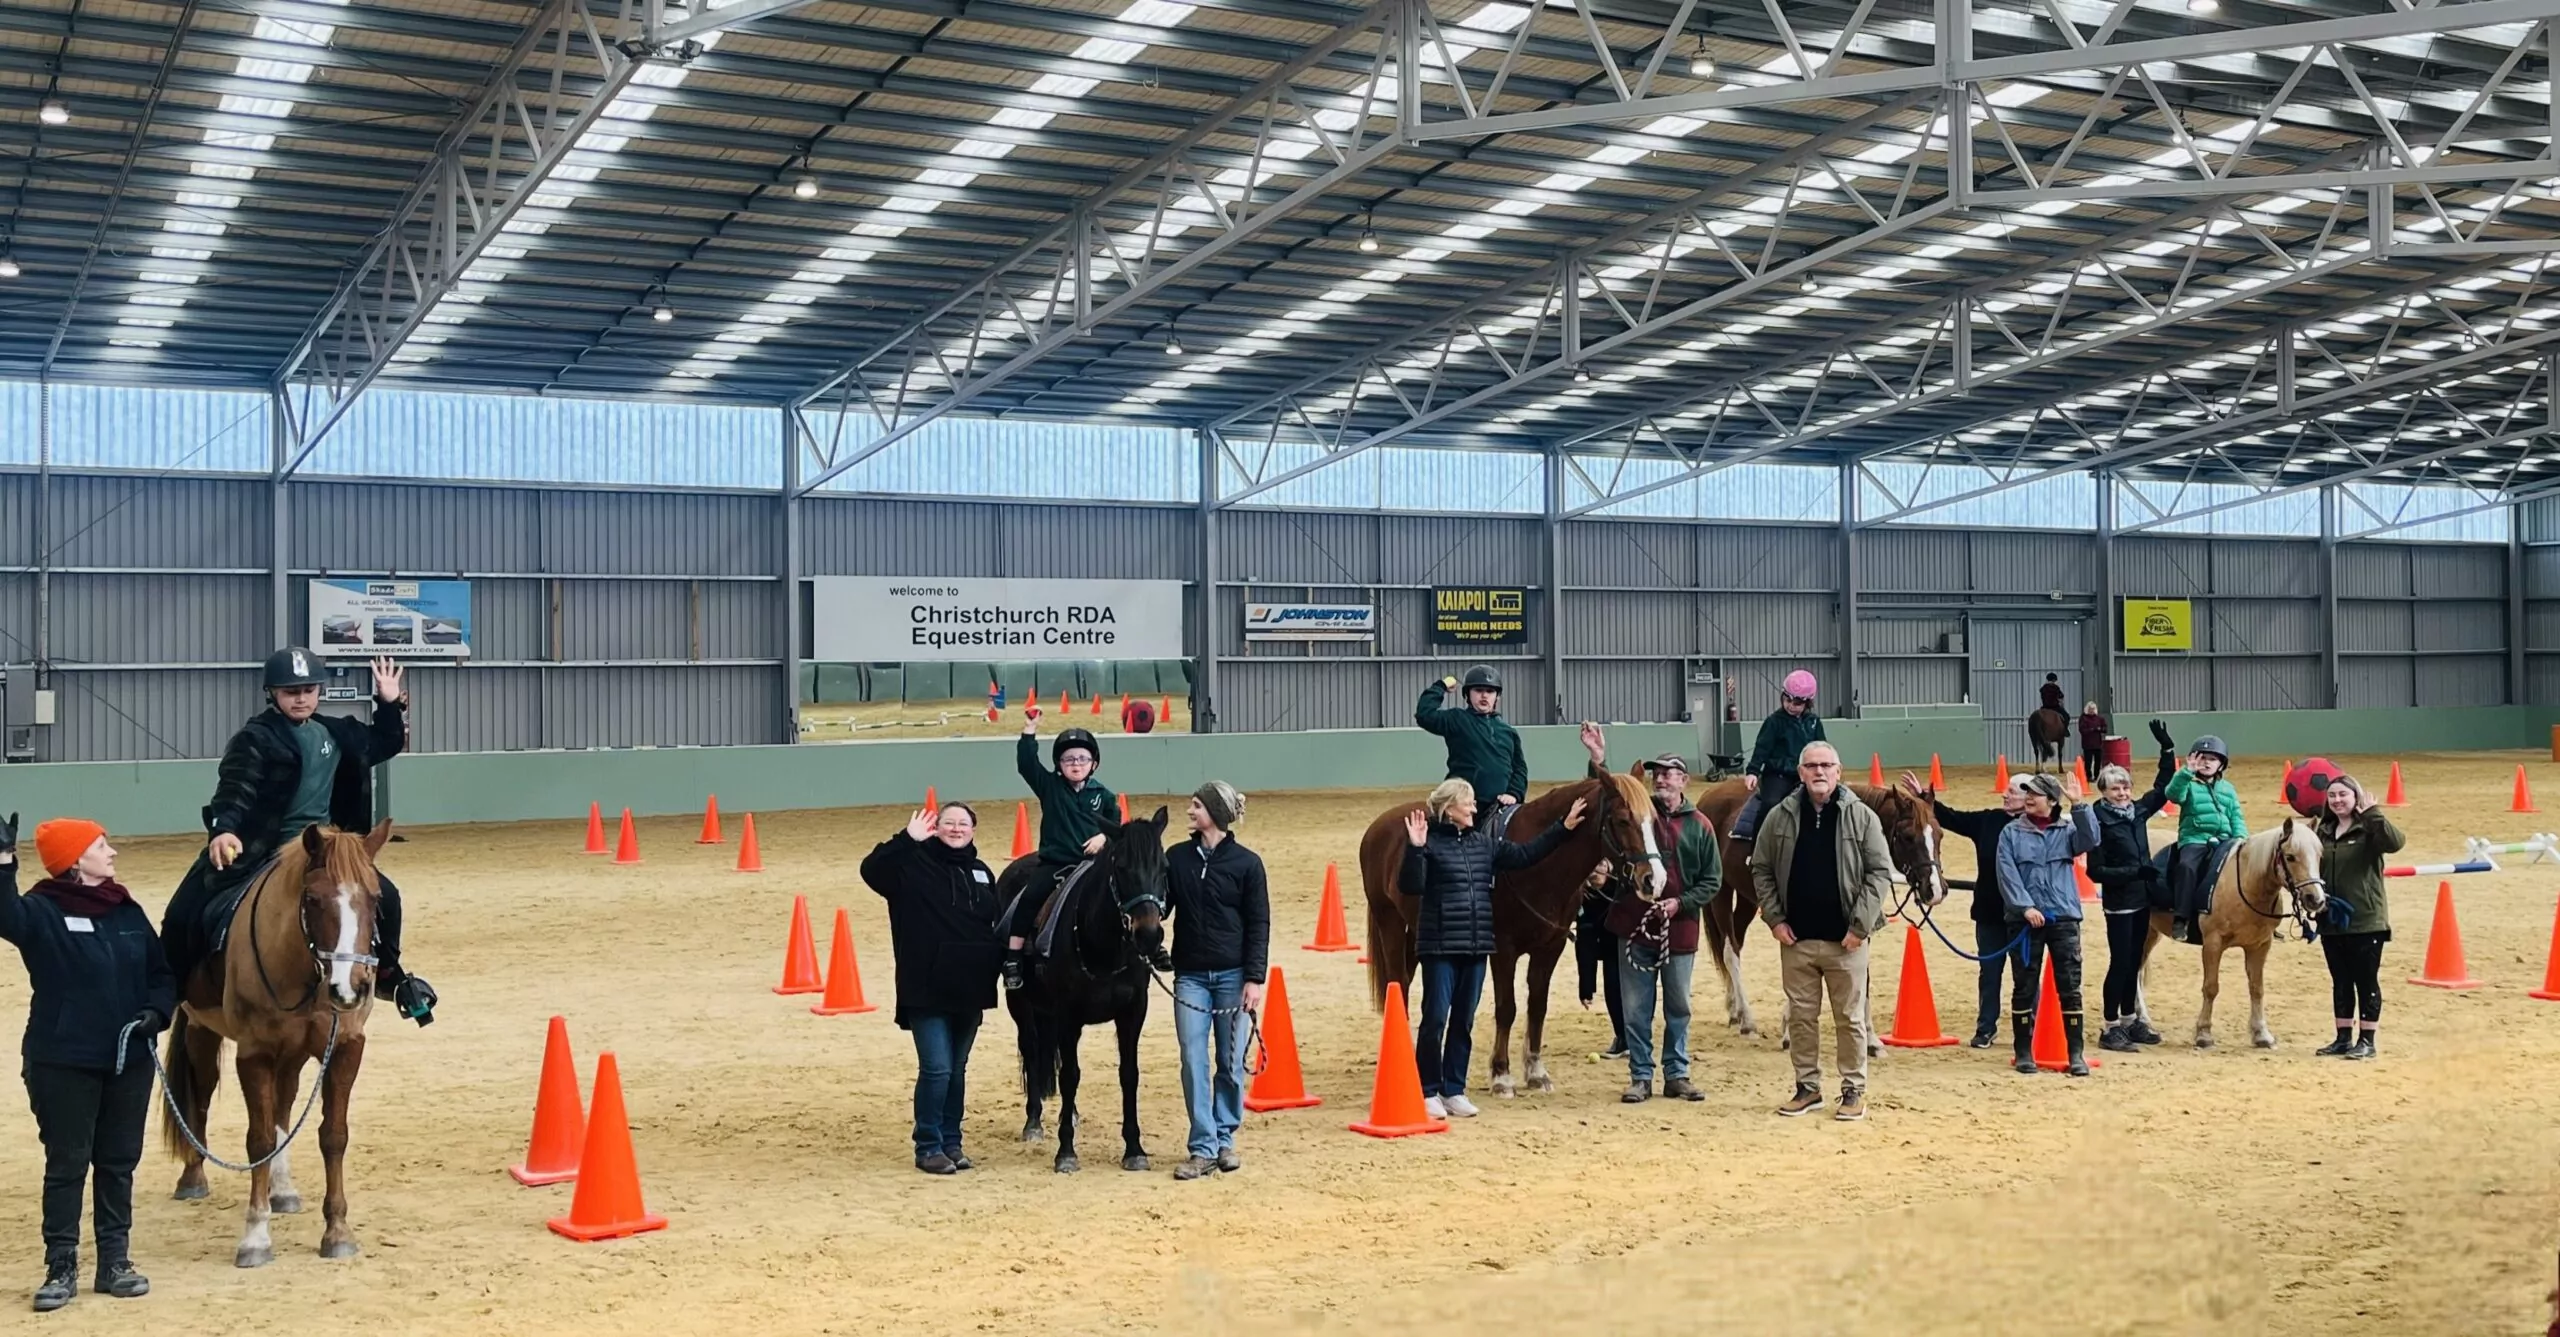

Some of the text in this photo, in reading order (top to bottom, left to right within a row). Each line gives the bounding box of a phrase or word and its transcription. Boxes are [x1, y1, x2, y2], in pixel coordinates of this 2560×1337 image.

[889, 585, 959, 596] welcome to
[1437, 590, 1486, 611] KAIAPOI
[911, 605, 1116, 624] Christchurch RDA
[1271, 608, 1370, 623] JOHNSTON
[1438, 621, 1522, 631] BUILDING NEEDS
[912, 627, 1115, 649] Equestrian Centre
